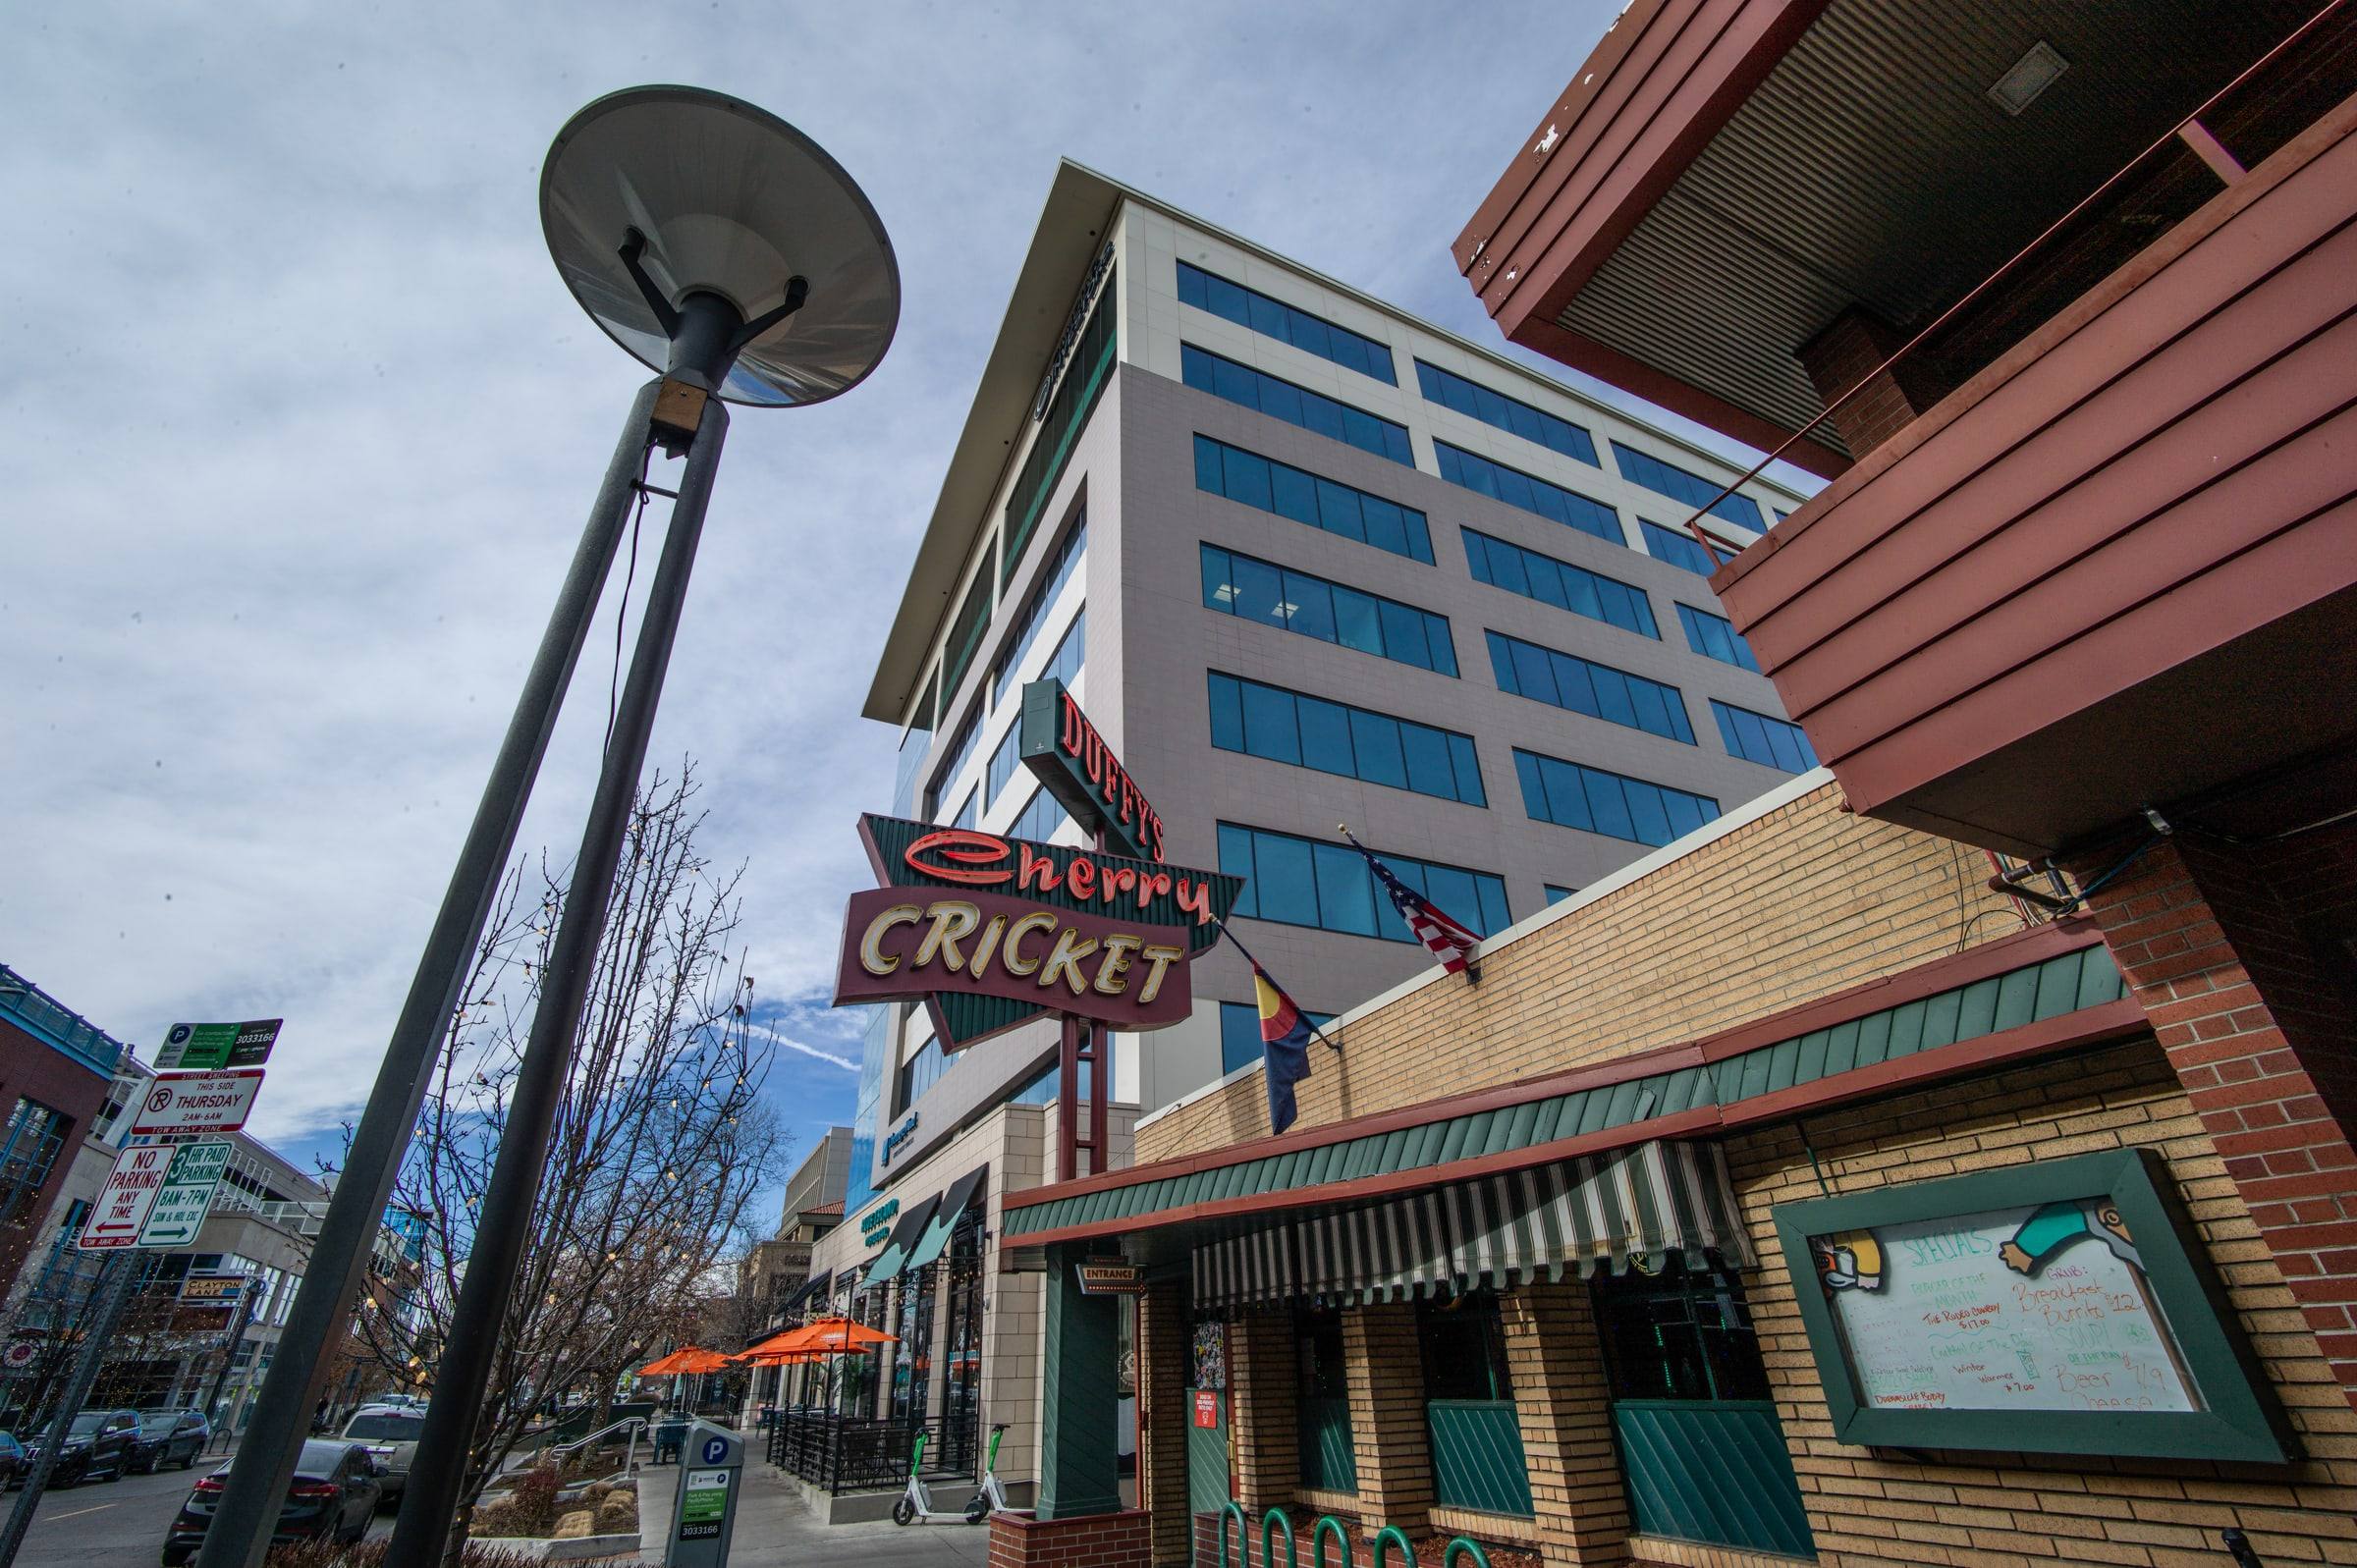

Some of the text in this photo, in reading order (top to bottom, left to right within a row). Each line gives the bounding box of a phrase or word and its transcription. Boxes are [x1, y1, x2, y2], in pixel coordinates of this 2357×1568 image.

[1063, 692, 1164, 863] DUFFY'S
[904, 830, 1210, 926] Cherry
[859, 900, 1185, 1003] CRICKET
[236, 1033, 275, 1045] 3033166
[176, 1094, 244, 1109] THURSDAY
[182, 1112, 223, 1121] 2AM-6AM
[132, 1151, 157, 1169] NO
[189, 1146, 227, 1163] HR PAID
[170, 1152, 187, 1178] 3
[179, 1163, 222, 1181] PARKING
[109, 1170, 161, 1190] PARKING
[116, 1191, 140, 1204] ANY
[159, 1189, 209, 1207] 8AM-7PM
[109, 1206, 135, 1219] TIME
[153, 1213, 165, 1222] SUN
[174, 1212, 185, 1221] HOL
[187, 1211, 199, 1221] EXC
[97, 1237, 114, 1246] AWAY
[1901, 1230, 1993, 1267] SPECIALS
[1086, 1269, 1133, 1278] ENTRANCE
[1922, 1312, 1942, 1325] THE
[683, 1525, 718, 1537] 3033166
